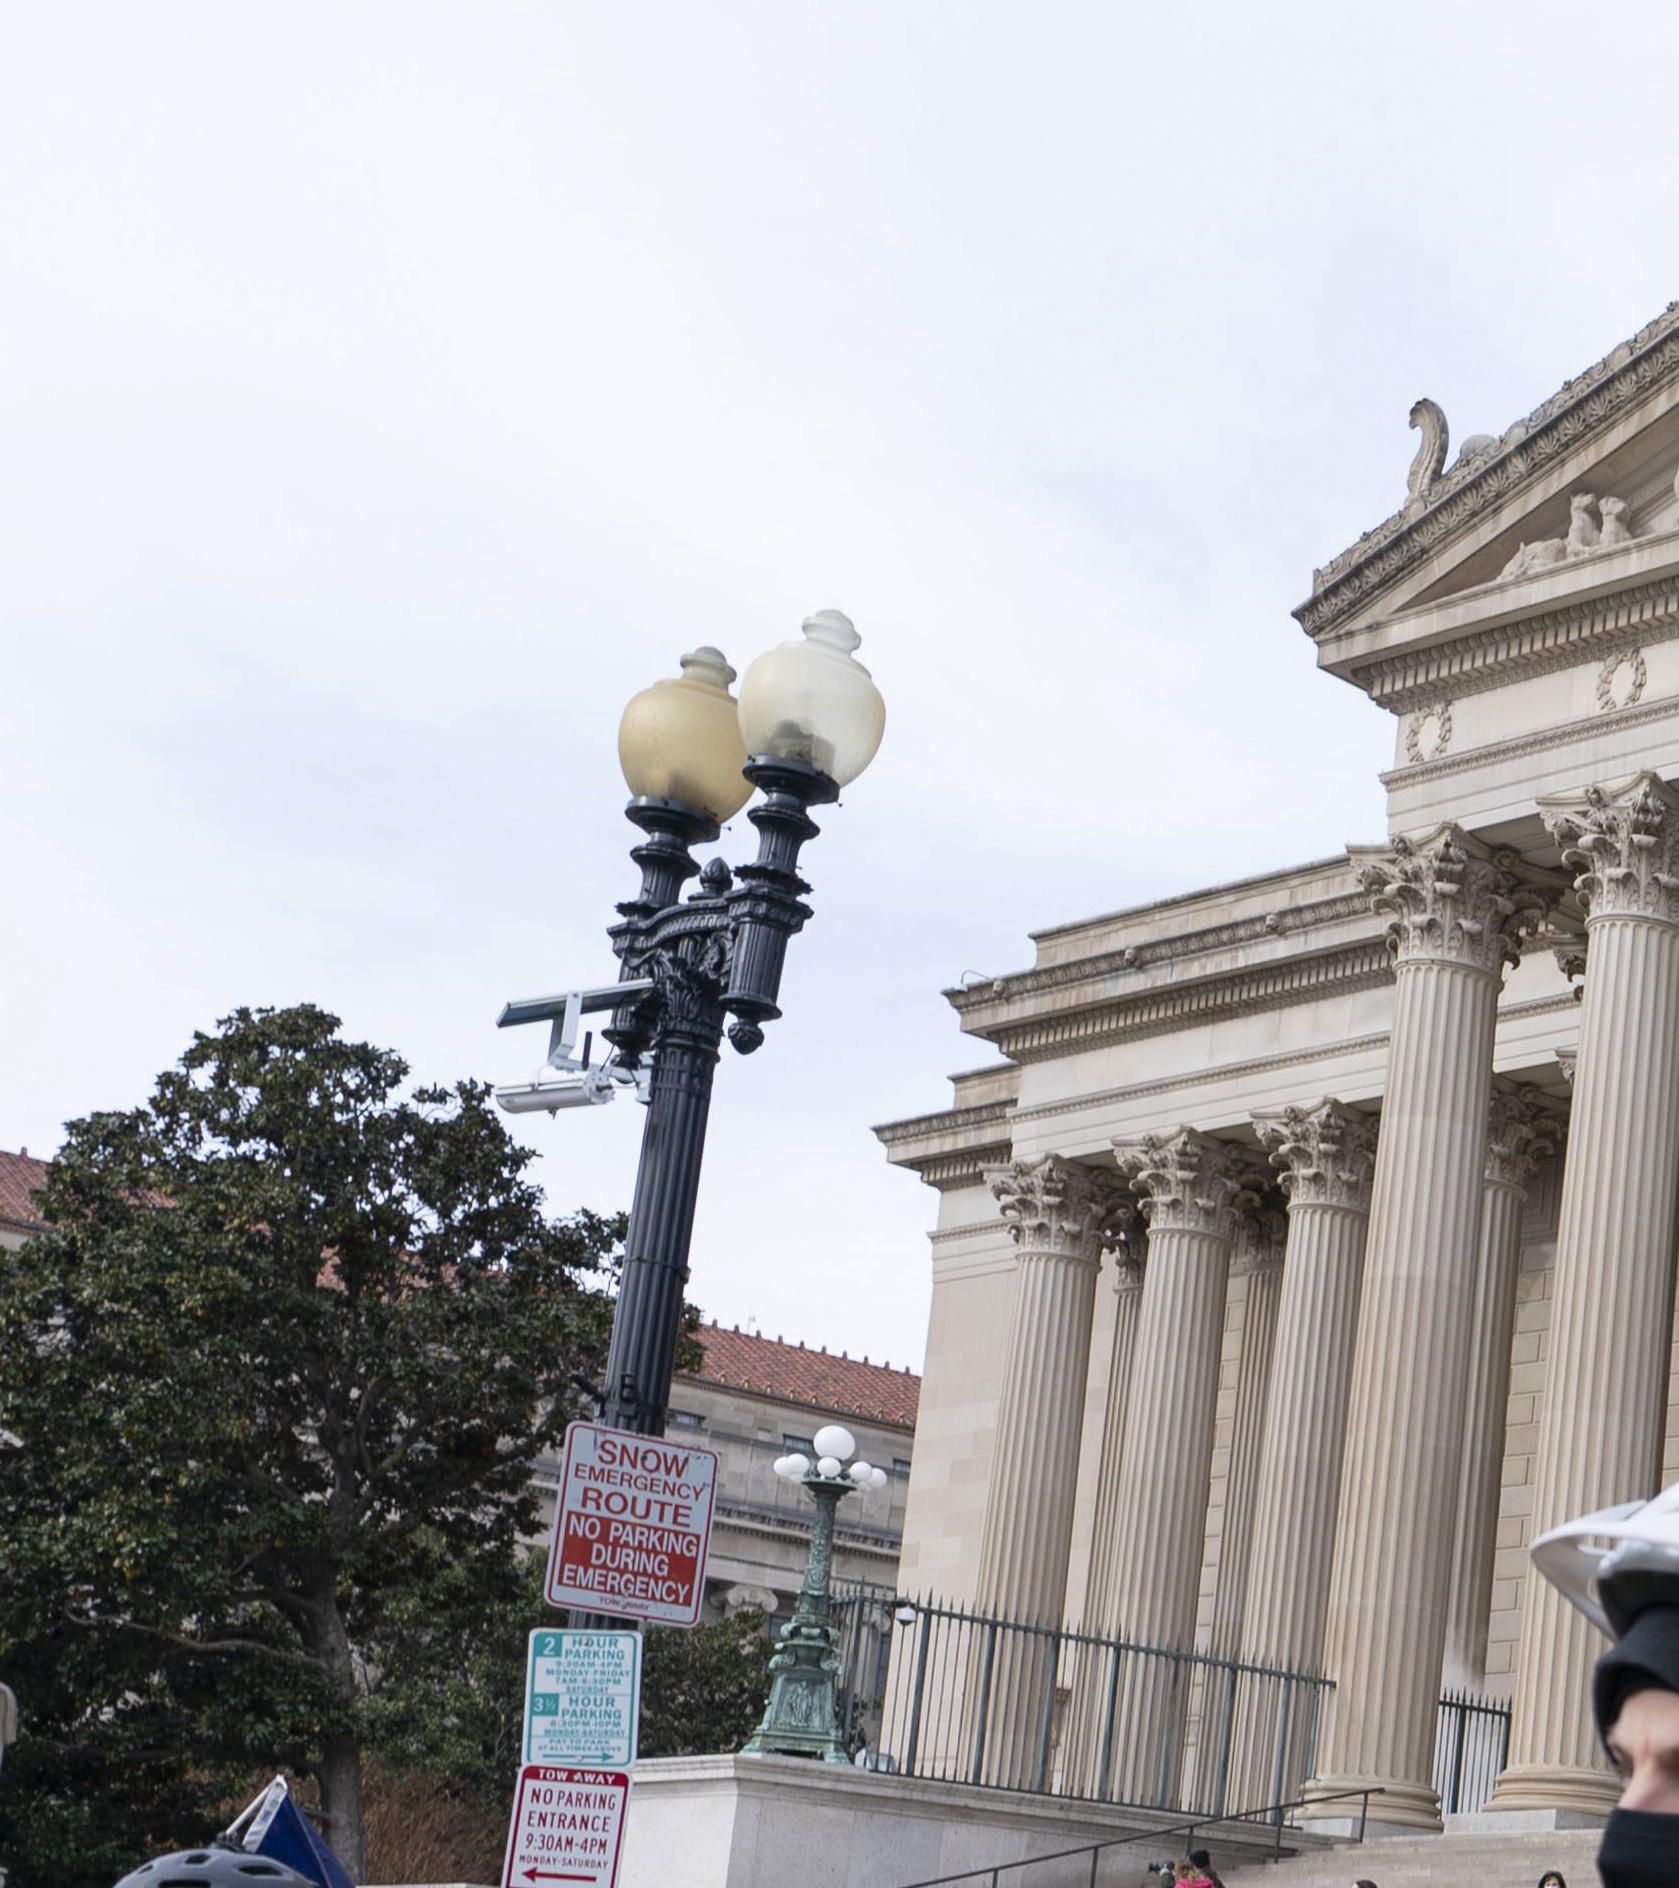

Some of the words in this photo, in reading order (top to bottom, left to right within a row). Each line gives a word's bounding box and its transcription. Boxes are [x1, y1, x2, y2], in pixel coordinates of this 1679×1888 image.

[598, 1440, 690, 1478] SNOW
[574, 1462, 705, 1502] EMERGENCY
[581, 1486, 693, 1528] ROUTE
[568, 1514, 601, 1540] NO
[608, 1521, 698, 1557] PARKING
[590, 1543, 670, 1577] DURING
[562, 1564, 691, 1604] EMERGENCY
[543, 1637, 556, 1656] 2
[564, 1648, 626, 1660] PARKING
[572, 1637, 619, 1648] HOUR
[569, 1696, 616, 1708] HOUR
[561, 1708, 623, 1720] PARKING
[538, 1769, 569, 1780] TOW
[573, 1771, 616, 1784] AWAY
[530, 1787, 554, 1805] NO
[556, 1790, 617, 1810] PARKING
[527, 1810, 612, 1833] ENTRANCE
[525, 1832, 608, 1855] 9:30AM-4PM
